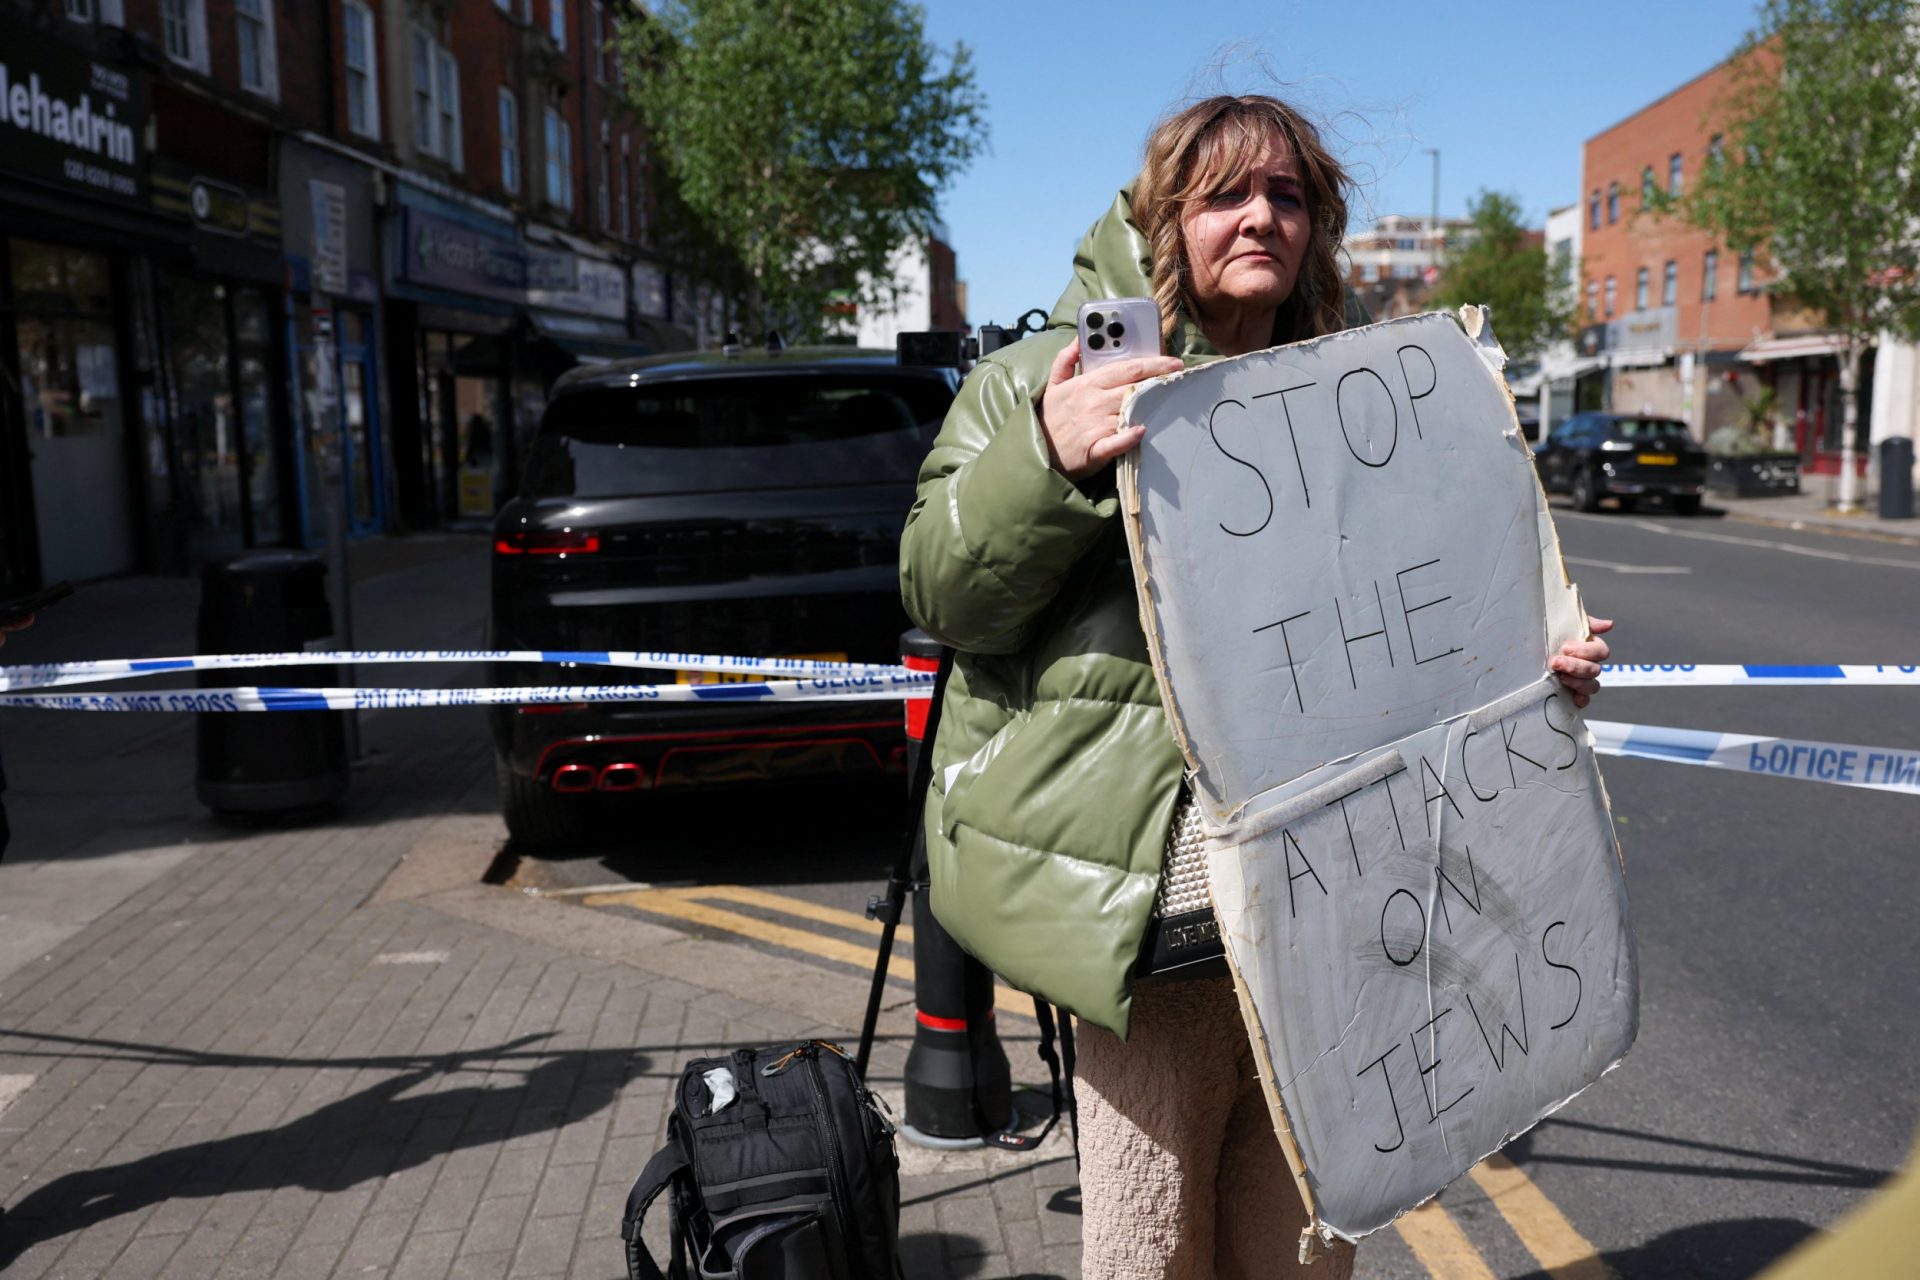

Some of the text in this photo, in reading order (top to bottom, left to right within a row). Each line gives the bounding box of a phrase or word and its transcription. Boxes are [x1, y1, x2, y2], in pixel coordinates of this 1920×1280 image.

[0, 62, 135, 165] ehadrin
[1209, 344, 1437, 537] STOP
[1253, 558, 1464, 714] THE
[1283, 694, 1578, 918] ATTACKS
[1381, 845, 1482, 966] ON
[1357, 921, 1582, 1153] JEWS
